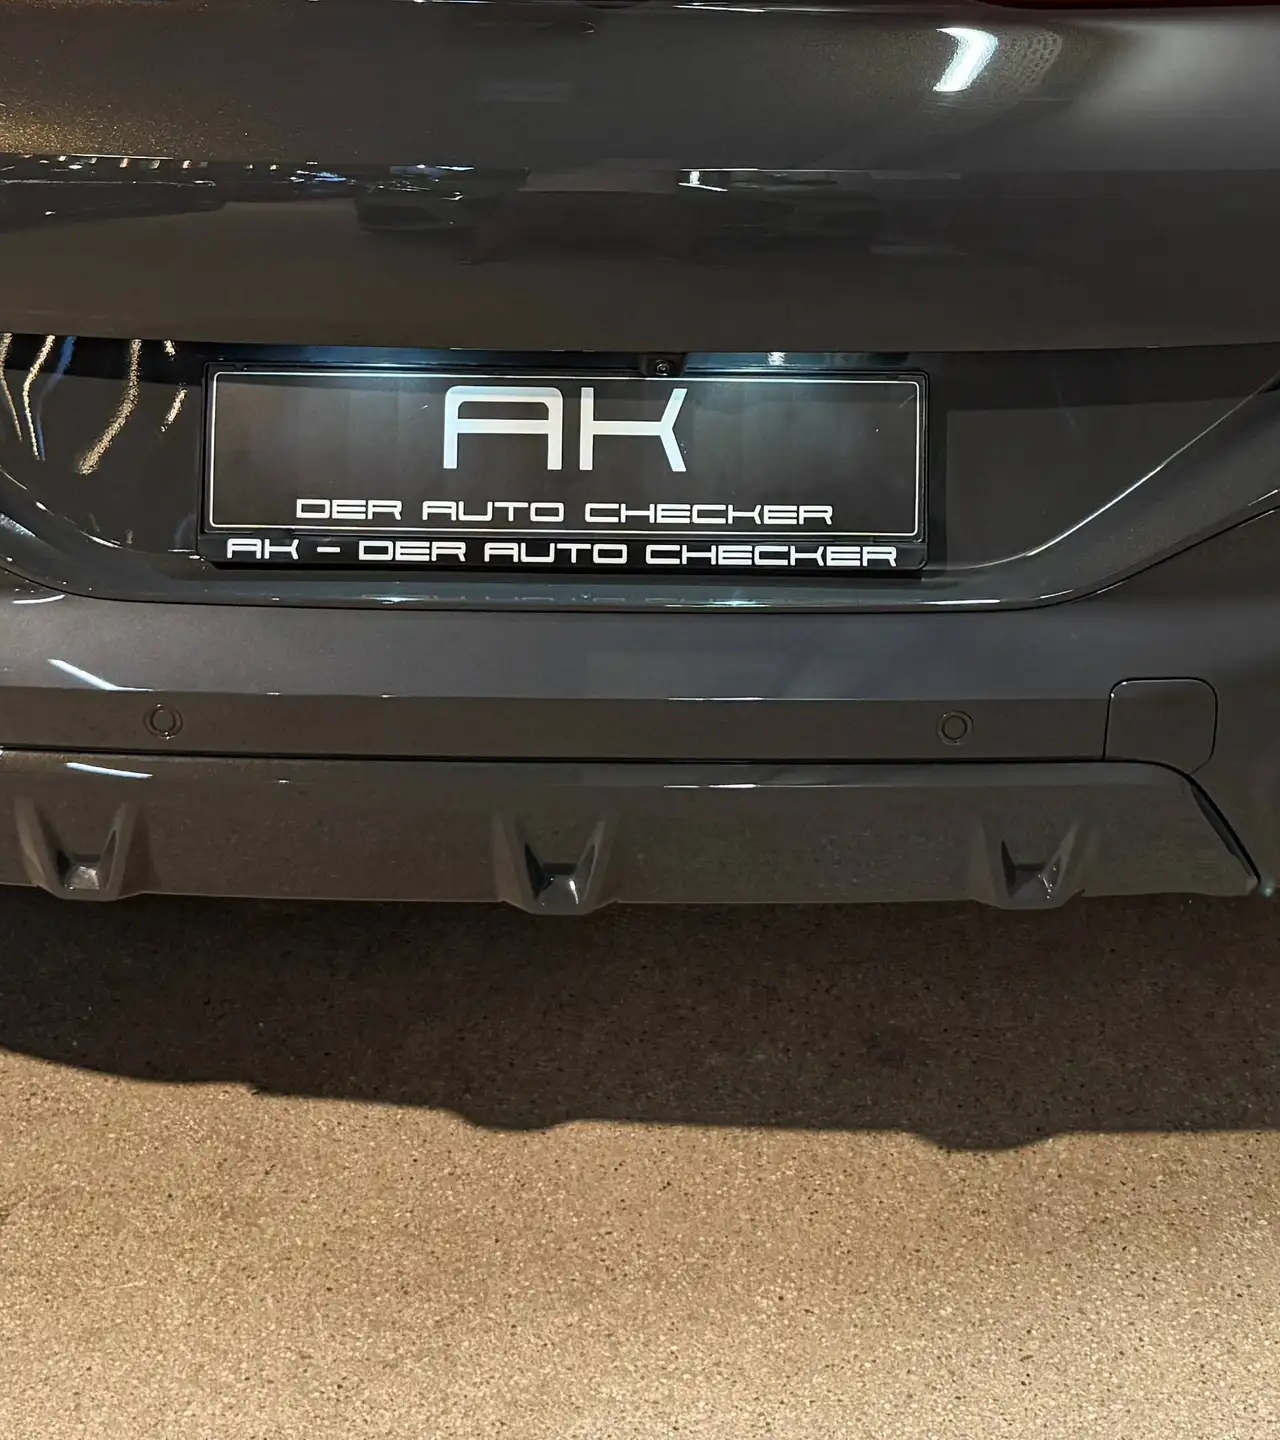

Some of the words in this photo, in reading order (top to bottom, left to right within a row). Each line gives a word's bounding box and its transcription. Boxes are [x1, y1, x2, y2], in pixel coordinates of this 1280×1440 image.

[444, 385, 688, 471] AK
[295, 498, 403, 521] DER
[421, 500, 565, 523] AUTO
[584, 502, 833, 525] CHECKER
[226, 538, 300, 560] AK
[357, 540, 466, 563] DER
[483, 542, 628, 564] AUTO
[645, 544, 898, 568] CHECKER
